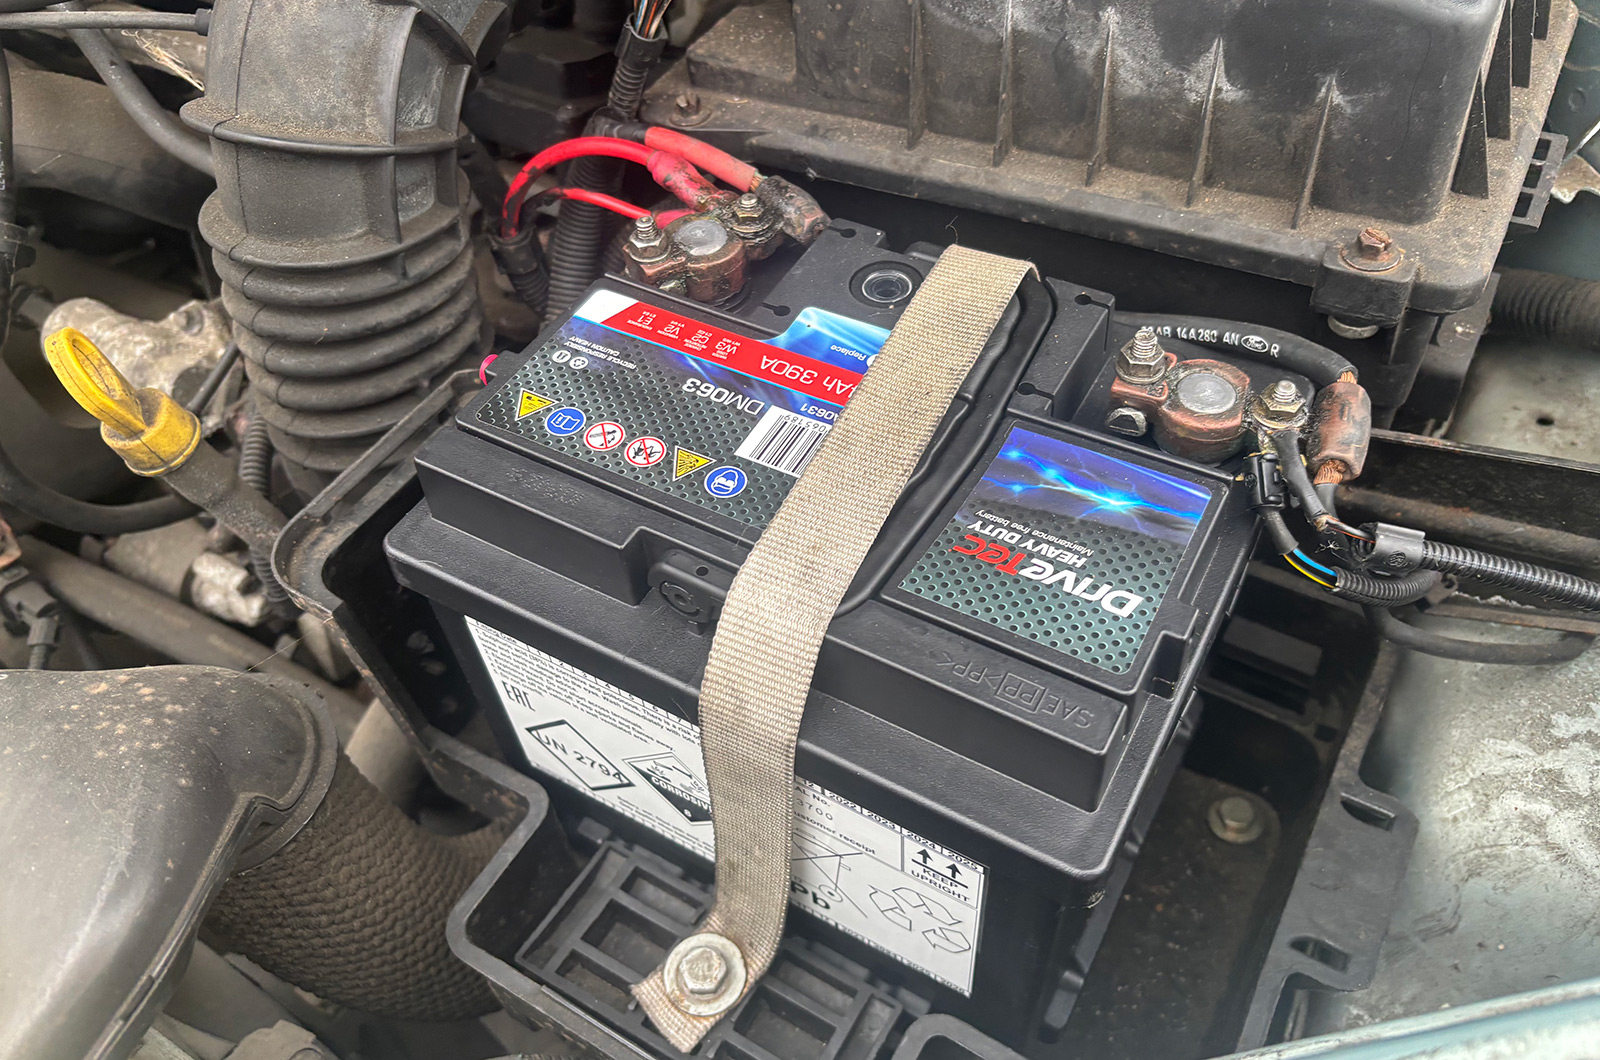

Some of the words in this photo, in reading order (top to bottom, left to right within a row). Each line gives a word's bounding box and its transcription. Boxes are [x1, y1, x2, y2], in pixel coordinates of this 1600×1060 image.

[637, 315, 653, 326] E1
[664, 323, 680, 335] V2
[563, 340, 608, 359] RESPONSIBLY
[568, 336, 591, 347] HEAVY
[590, 343, 621, 356] CAUTION
[691, 333, 709, 344] C2
[715, 341, 737, 354] W3
[1176, 327, 1217, 343] 14A280
[1222, 332, 1240, 346] AN
[1270, 343, 1280, 358] R
[605, 355, 637, 370] RECYCLE
[830, 344, 868, 361] Replace
[760, 355, 819, 385] 390A
[681, 377, 766, 416] DM063
[783, 413, 827, 433] 065189
[975, 509, 1011, 529] battery
[1011, 521, 1031, 535] free
[967, 520, 1024, 544] DUTY
[1031, 528, 1094, 556] Maintenance
[1021, 538, 1088, 568] HEAVY
[1041, 693, 1095, 729] SAE
[534, 729, 569, 756] UN
[573, 749, 626, 785] 2794
[794, 785, 810, 797] AL
[812, 793, 831, 807] No.
[795, 798, 834, 821] 3700
[793, 811, 836, 834] ustomer
[838, 833, 876, 856] receipt
[828, 791, 857, 809] 2022
[866, 811, 896, 831] 2023
[906, 830, 936, 850] 2024
[947, 851, 979, 871] 2025
[911, 869, 970, 902] UPRIGHT
[922, 867, 959, 889] KEEP
[790, 880, 831, 910] Pb
